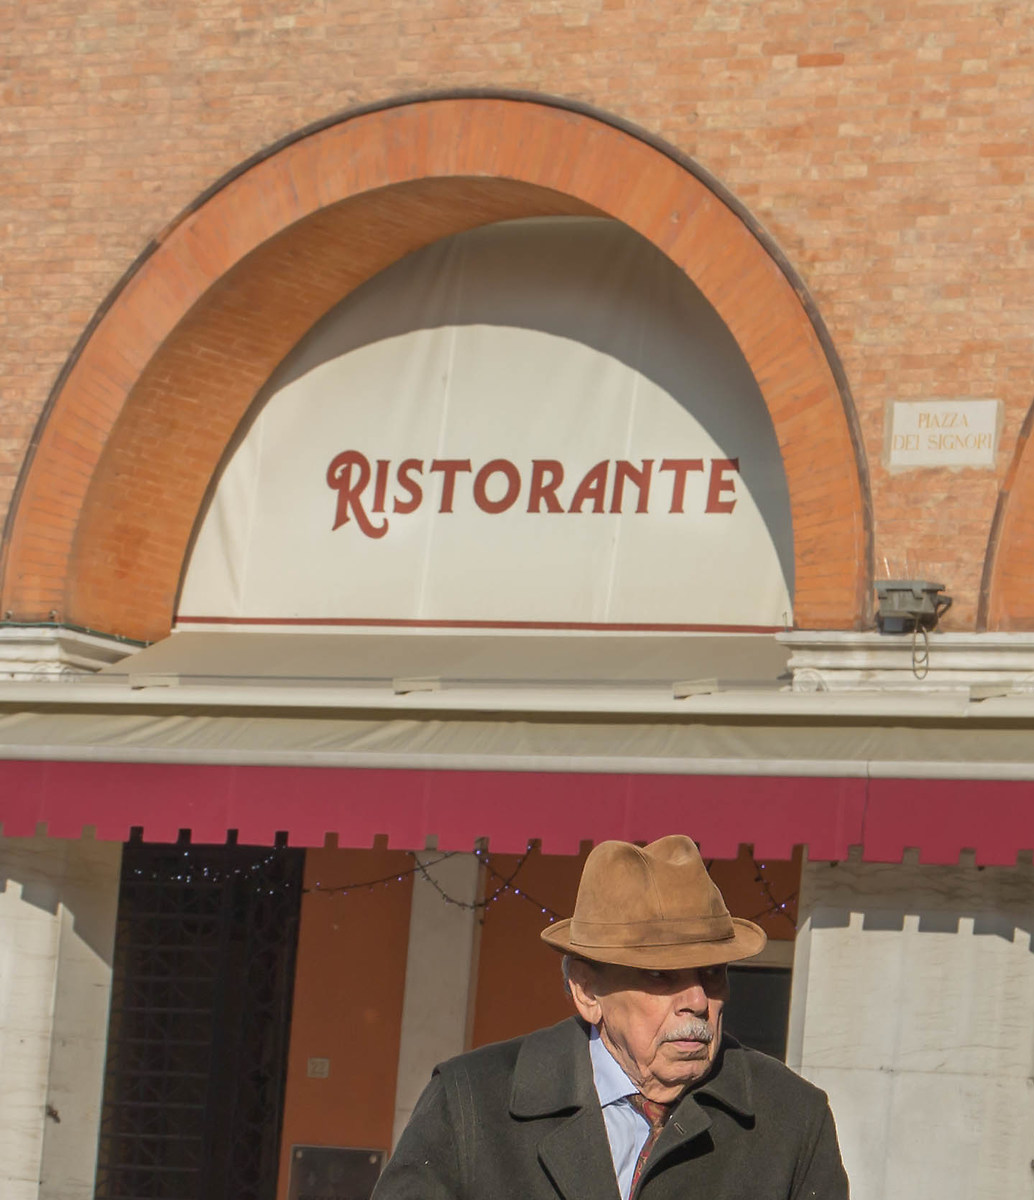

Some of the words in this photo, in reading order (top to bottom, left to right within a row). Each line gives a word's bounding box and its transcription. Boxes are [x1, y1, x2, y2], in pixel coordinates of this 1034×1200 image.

[918, 412, 968, 428] PIAZZA
[893, 434, 920, 449] DEI
[927, 432, 993, 450] SIGNORI
[326, 449, 740, 539] RISTORANTE
